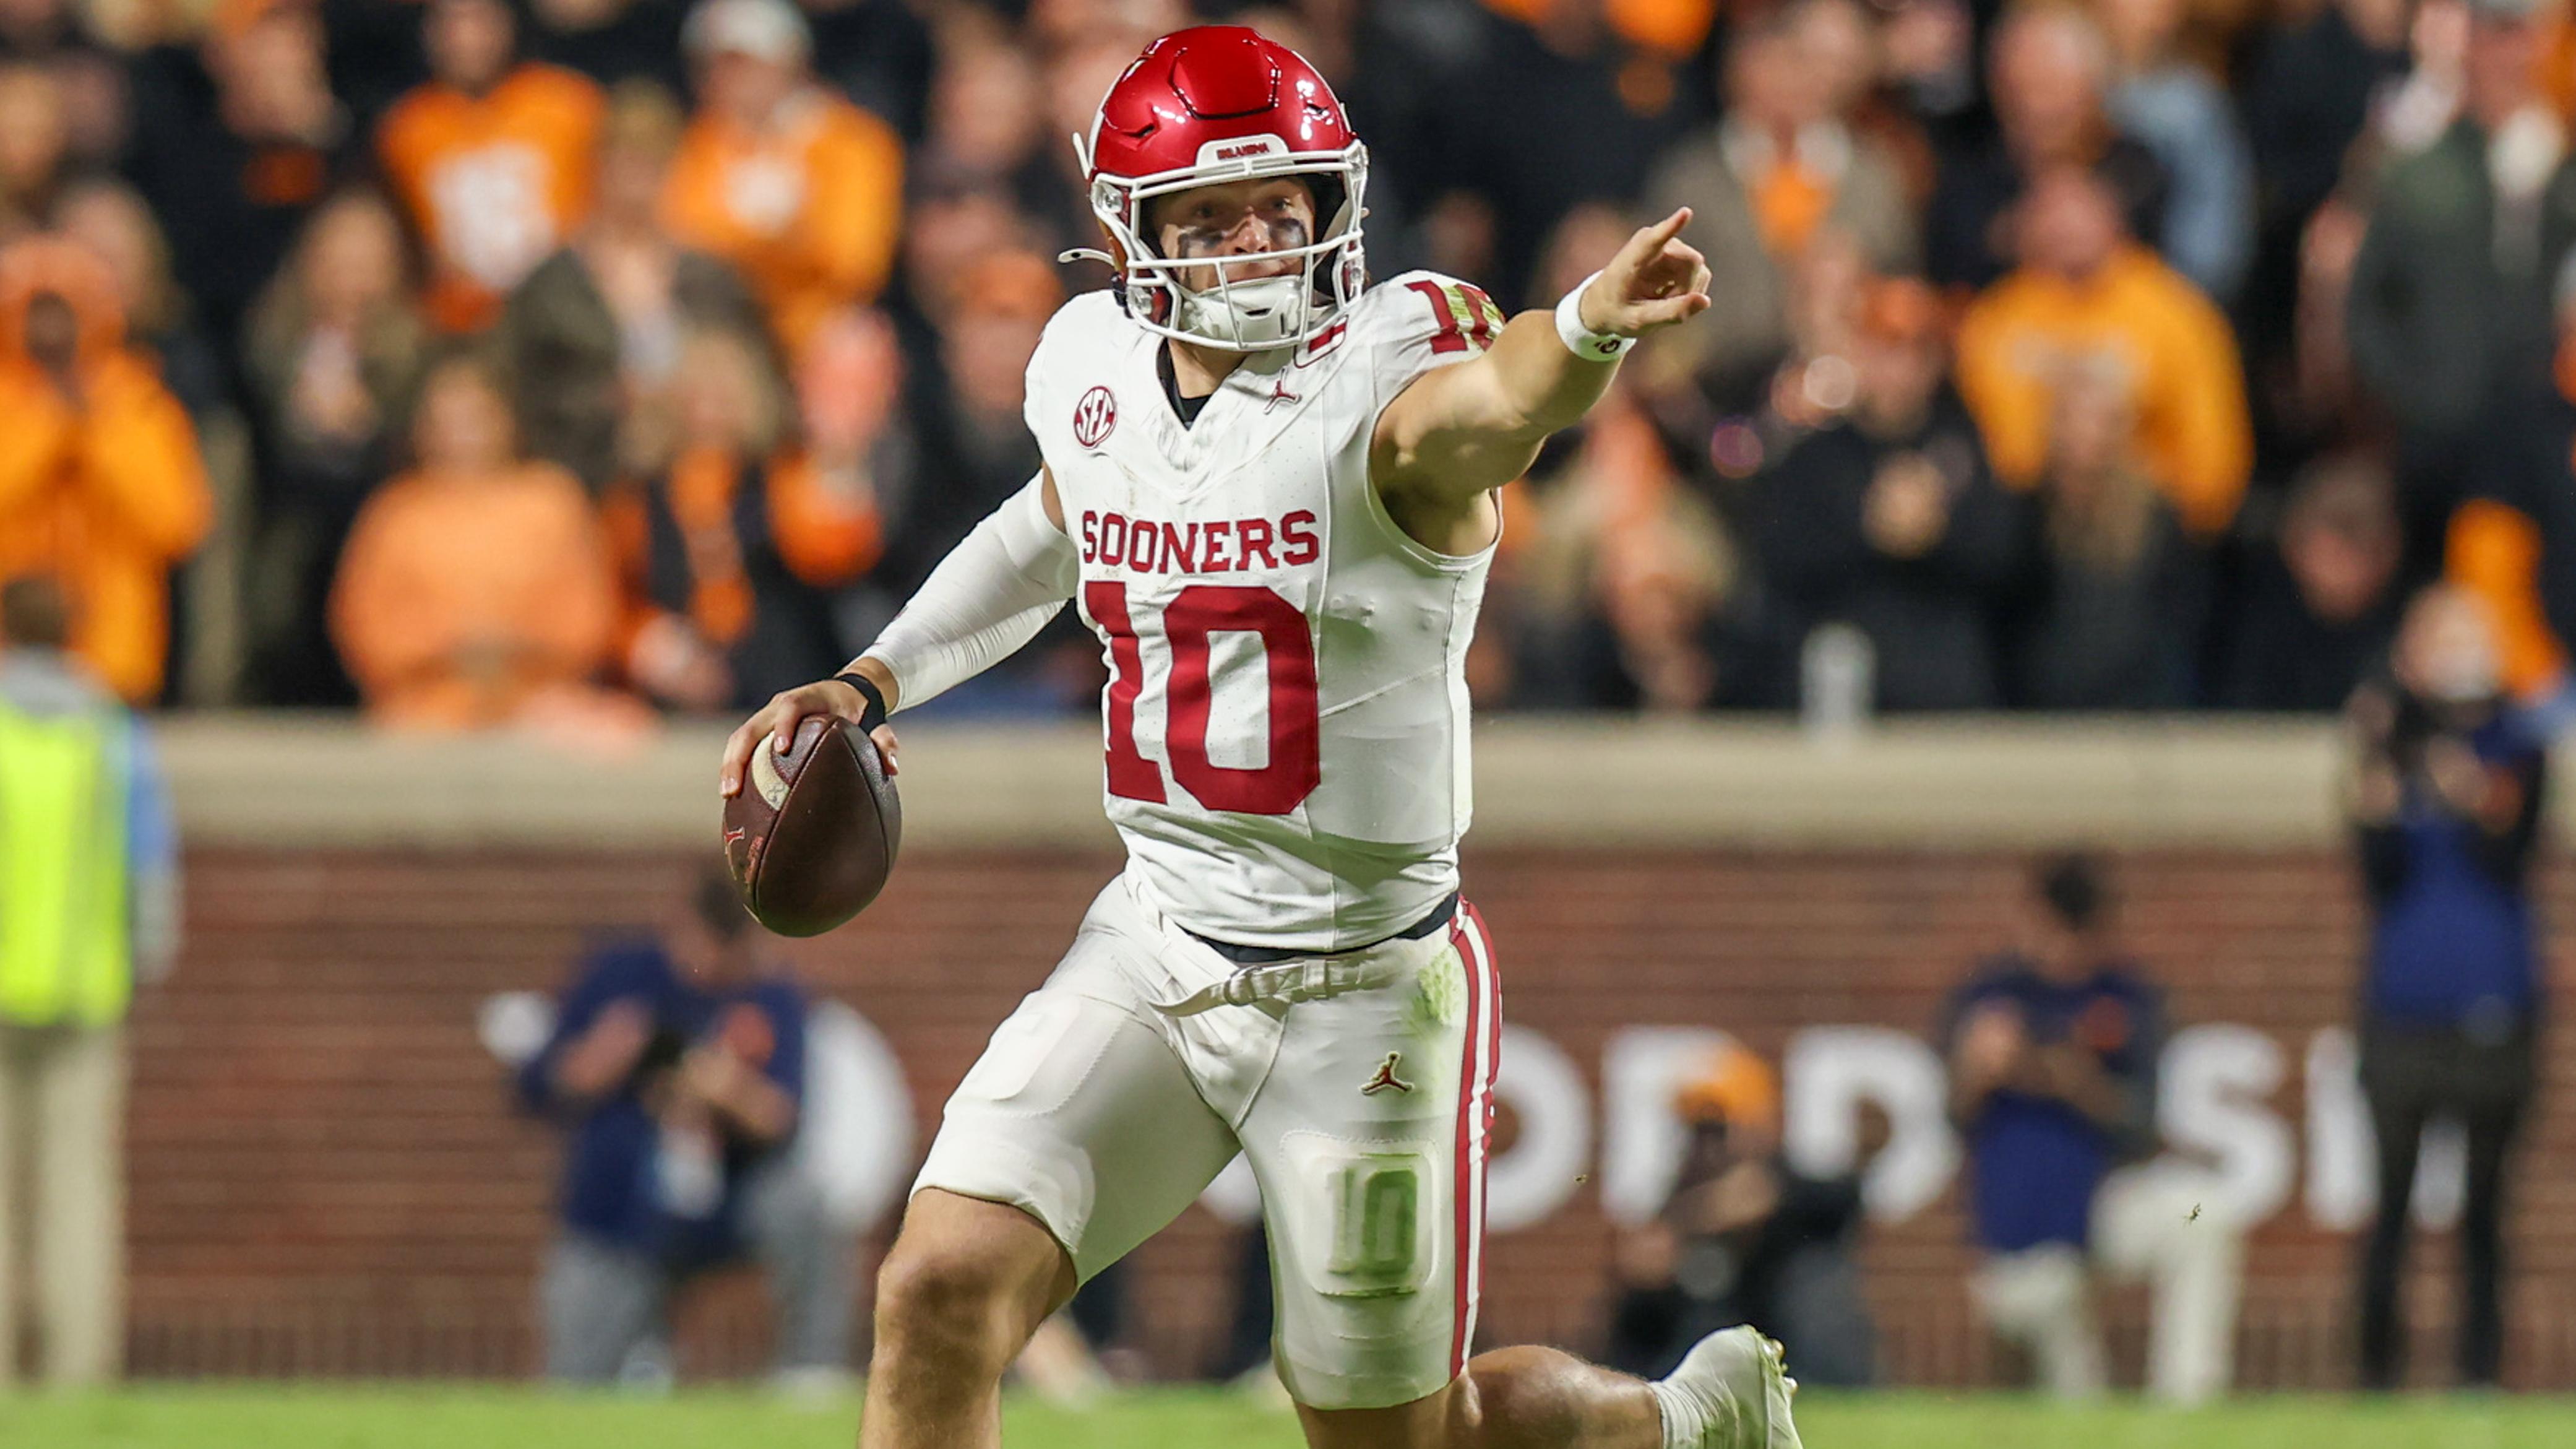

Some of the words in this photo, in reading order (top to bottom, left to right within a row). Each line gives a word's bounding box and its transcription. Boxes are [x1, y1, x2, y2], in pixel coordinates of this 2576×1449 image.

[1075, 386, 1116, 447] SEC
[1082, 509, 1319, 574] SOONERS
[1083, 581, 1320, 815] 10
[1327, 1167, 1417, 1276] 10
